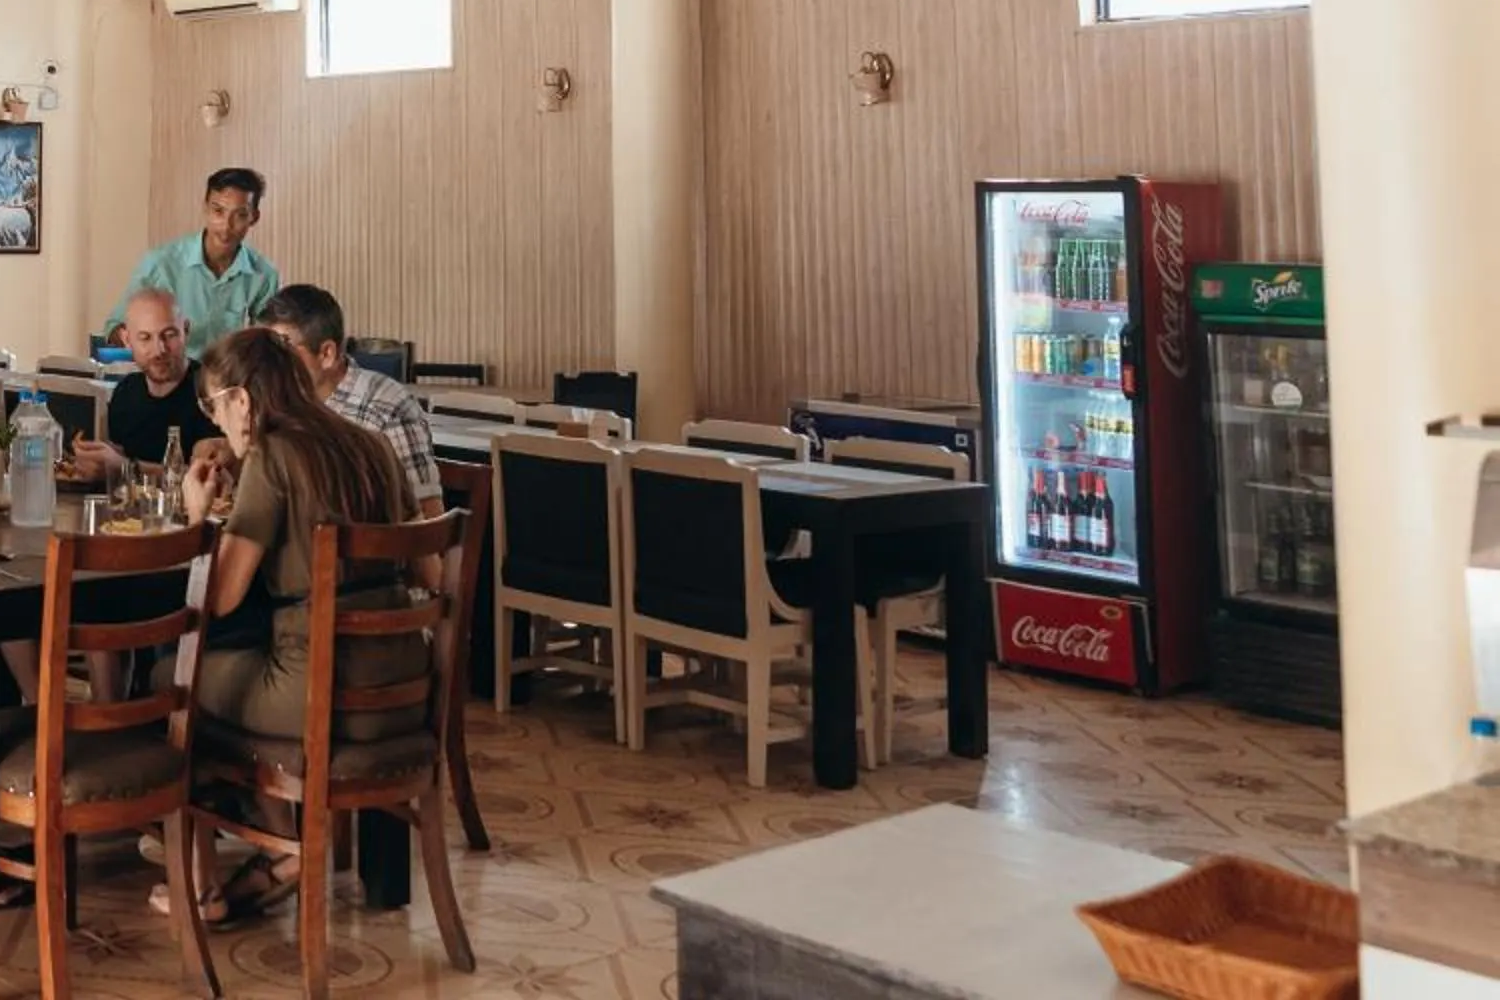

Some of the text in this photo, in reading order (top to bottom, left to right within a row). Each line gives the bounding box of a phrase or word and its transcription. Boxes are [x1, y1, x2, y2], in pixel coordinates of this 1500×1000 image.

[1152, 193, 1188, 378] Coca-Cola
[1252, 278, 1302, 307] Sprite
[1012, 615, 1114, 661] Coca-Cola
